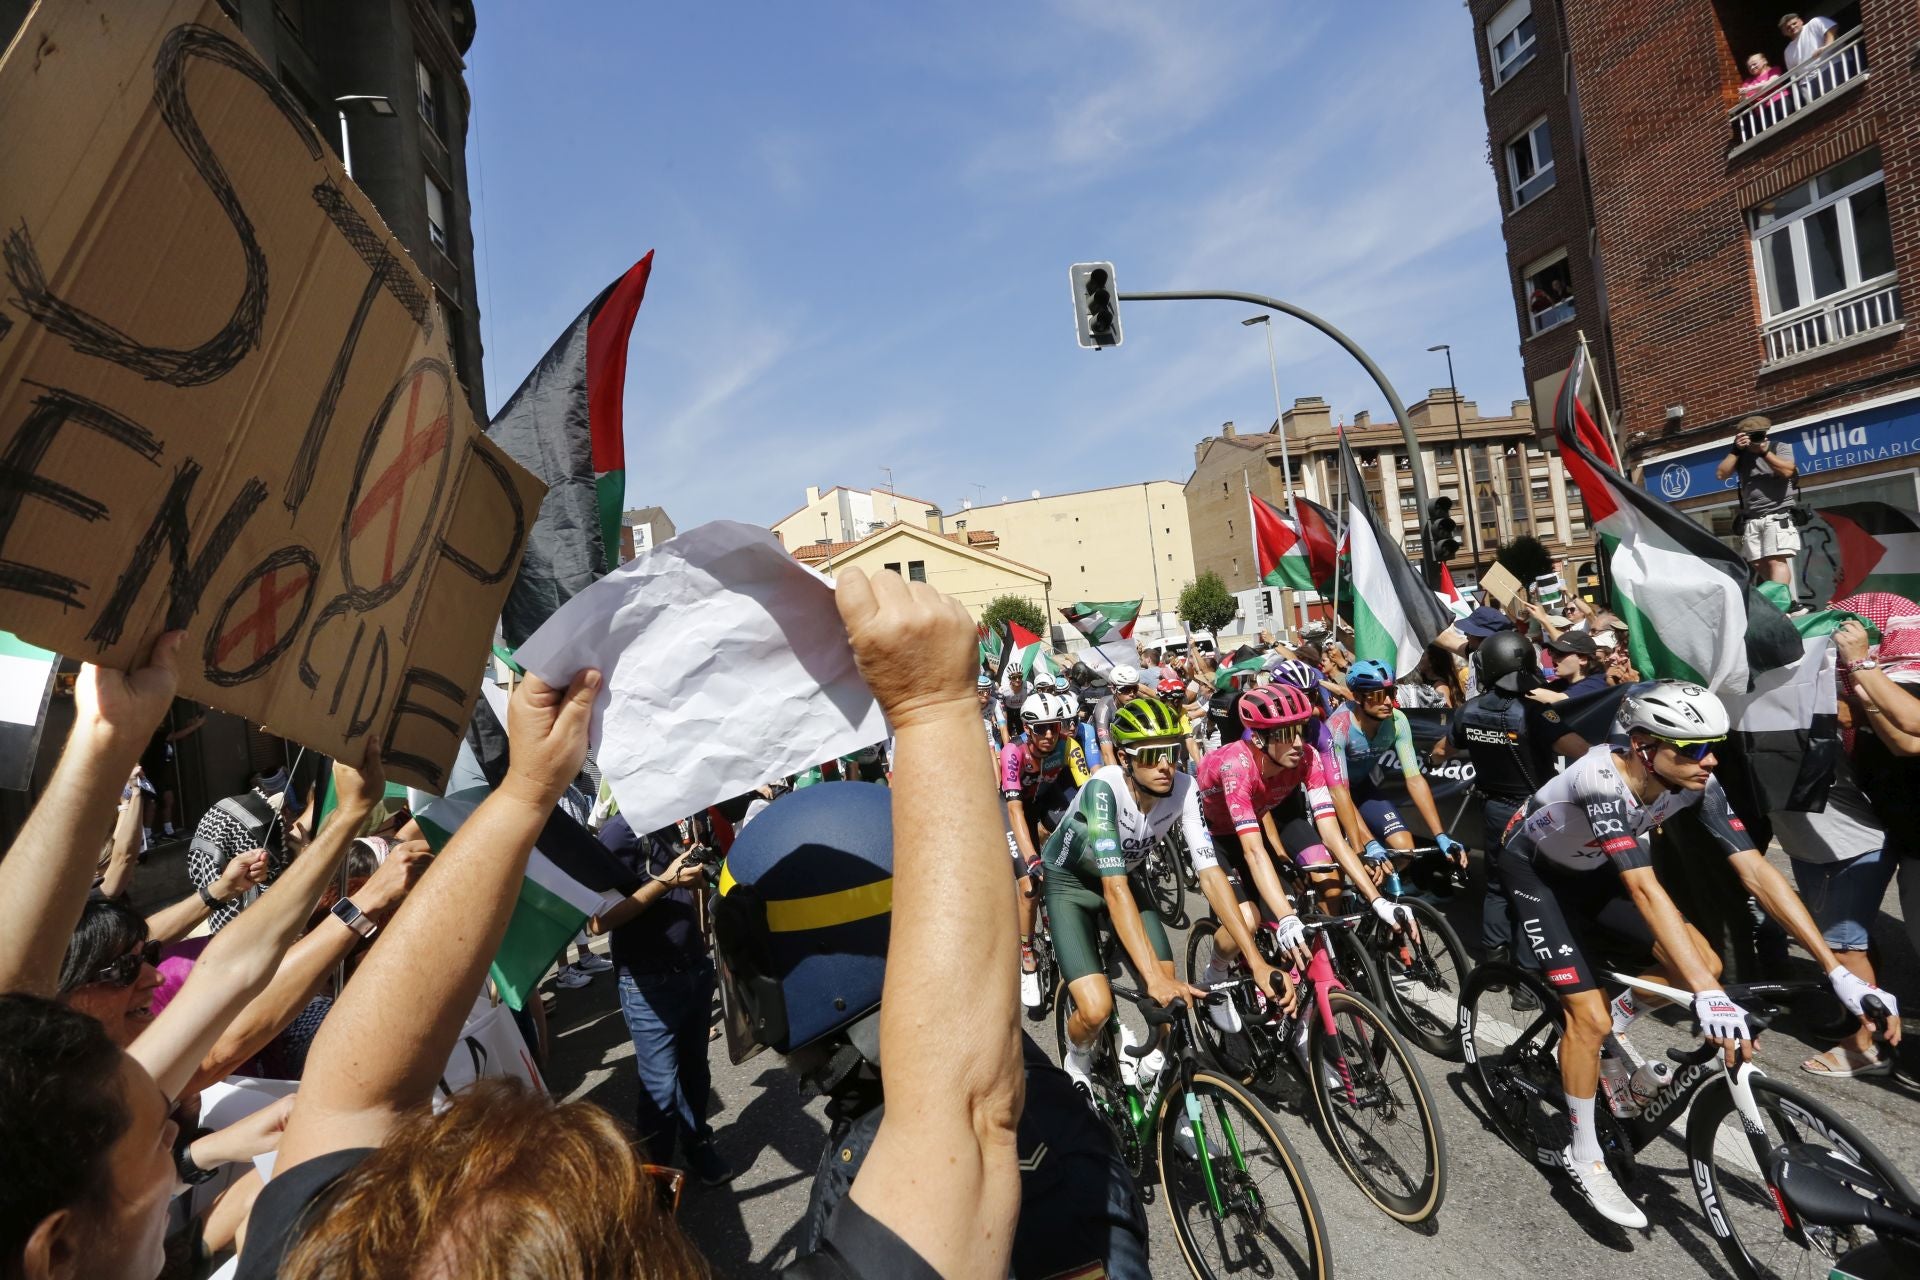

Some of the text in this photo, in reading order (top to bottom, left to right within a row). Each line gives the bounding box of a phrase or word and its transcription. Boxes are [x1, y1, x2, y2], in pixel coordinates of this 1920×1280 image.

[3, 22, 526, 642] STOP
[1801, 422, 1867, 456] Villa
[0, 376, 467, 787] ENOCIDE
[1467, 734, 1519, 746] NACIONAL
[1096, 791, 1109, 831] ALEA
[1523, 918, 1553, 960] UAE
[1549, 972, 1574, 982] rates
[1643, 1064, 1701, 1123] COLNAGO
